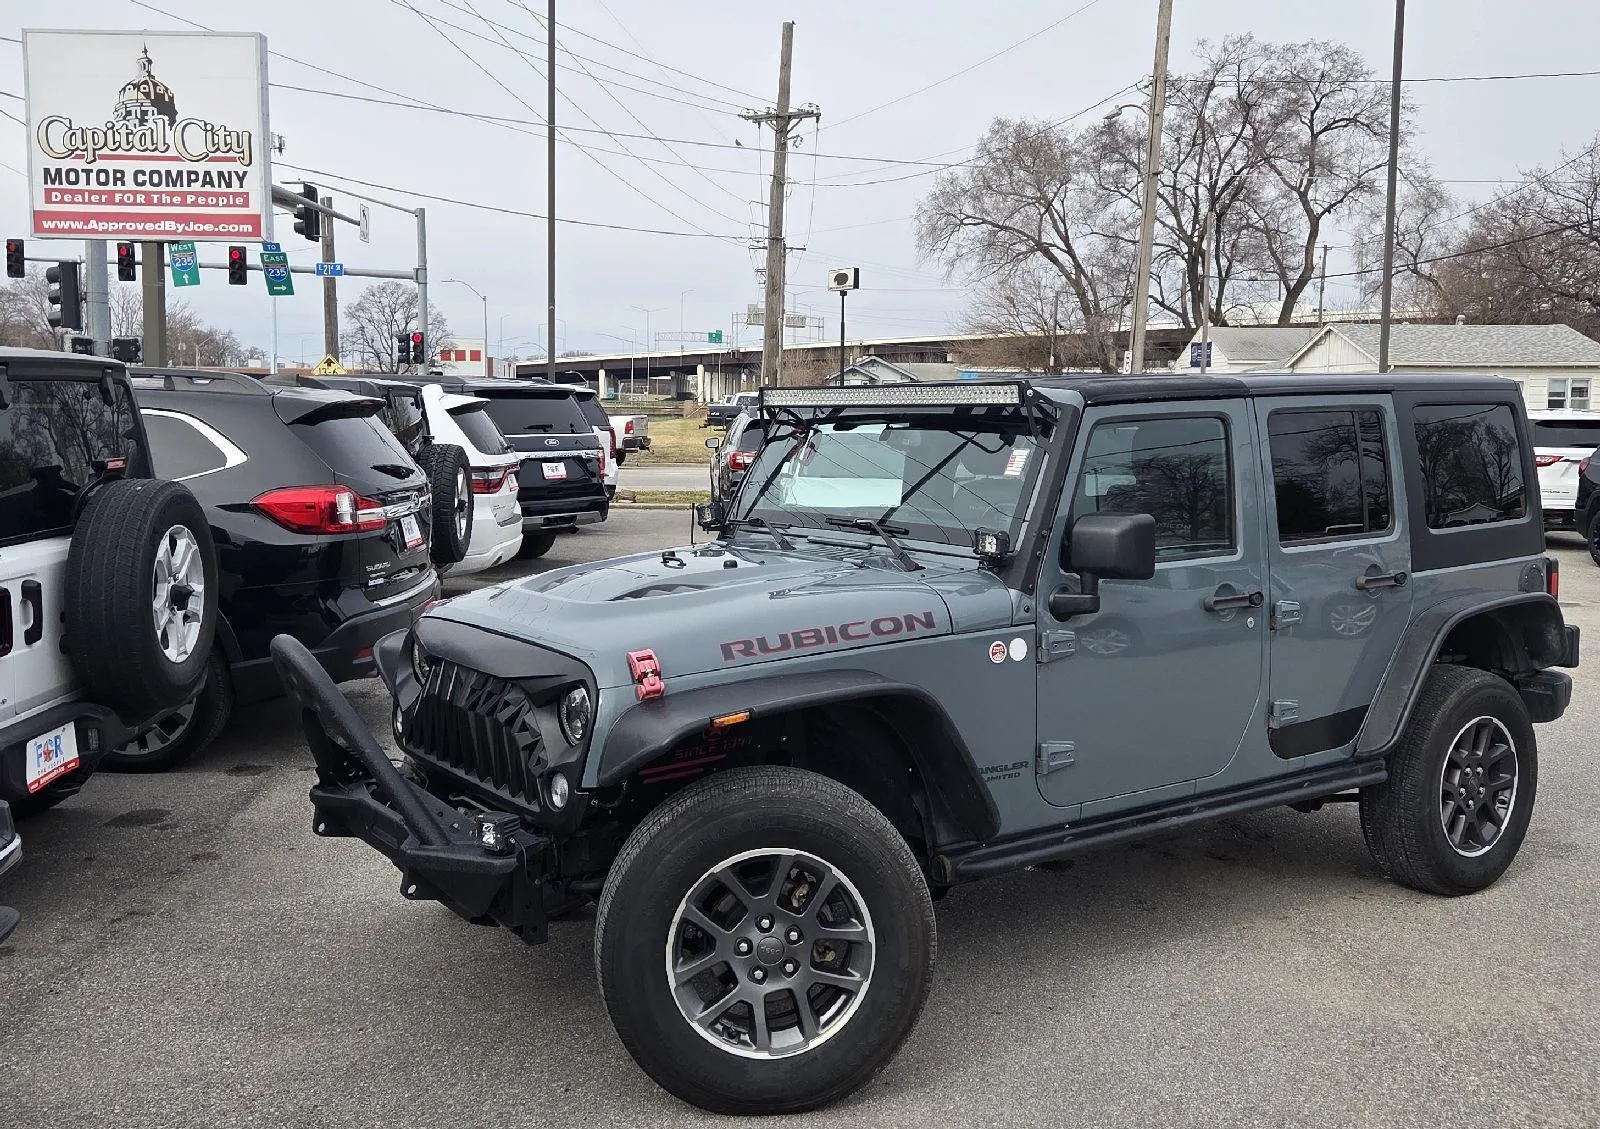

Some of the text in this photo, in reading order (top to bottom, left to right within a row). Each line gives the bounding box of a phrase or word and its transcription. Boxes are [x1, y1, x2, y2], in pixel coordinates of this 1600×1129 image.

[37, 115, 252, 166] Capital City
[43, 168, 248, 188] MOTOR COMPANY
[51, 191, 244, 207] Dealer FOR The People
[42, 219, 253, 233] www.ApprovedByJoe.com
[171, 243, 193, 252] WEST
[175, 257, 194, 267] 235
[269, 268, 287, 277] 235
[720, 611, 936, 662] RUBICON
[978, 761, 1029, 774] ANGLER
